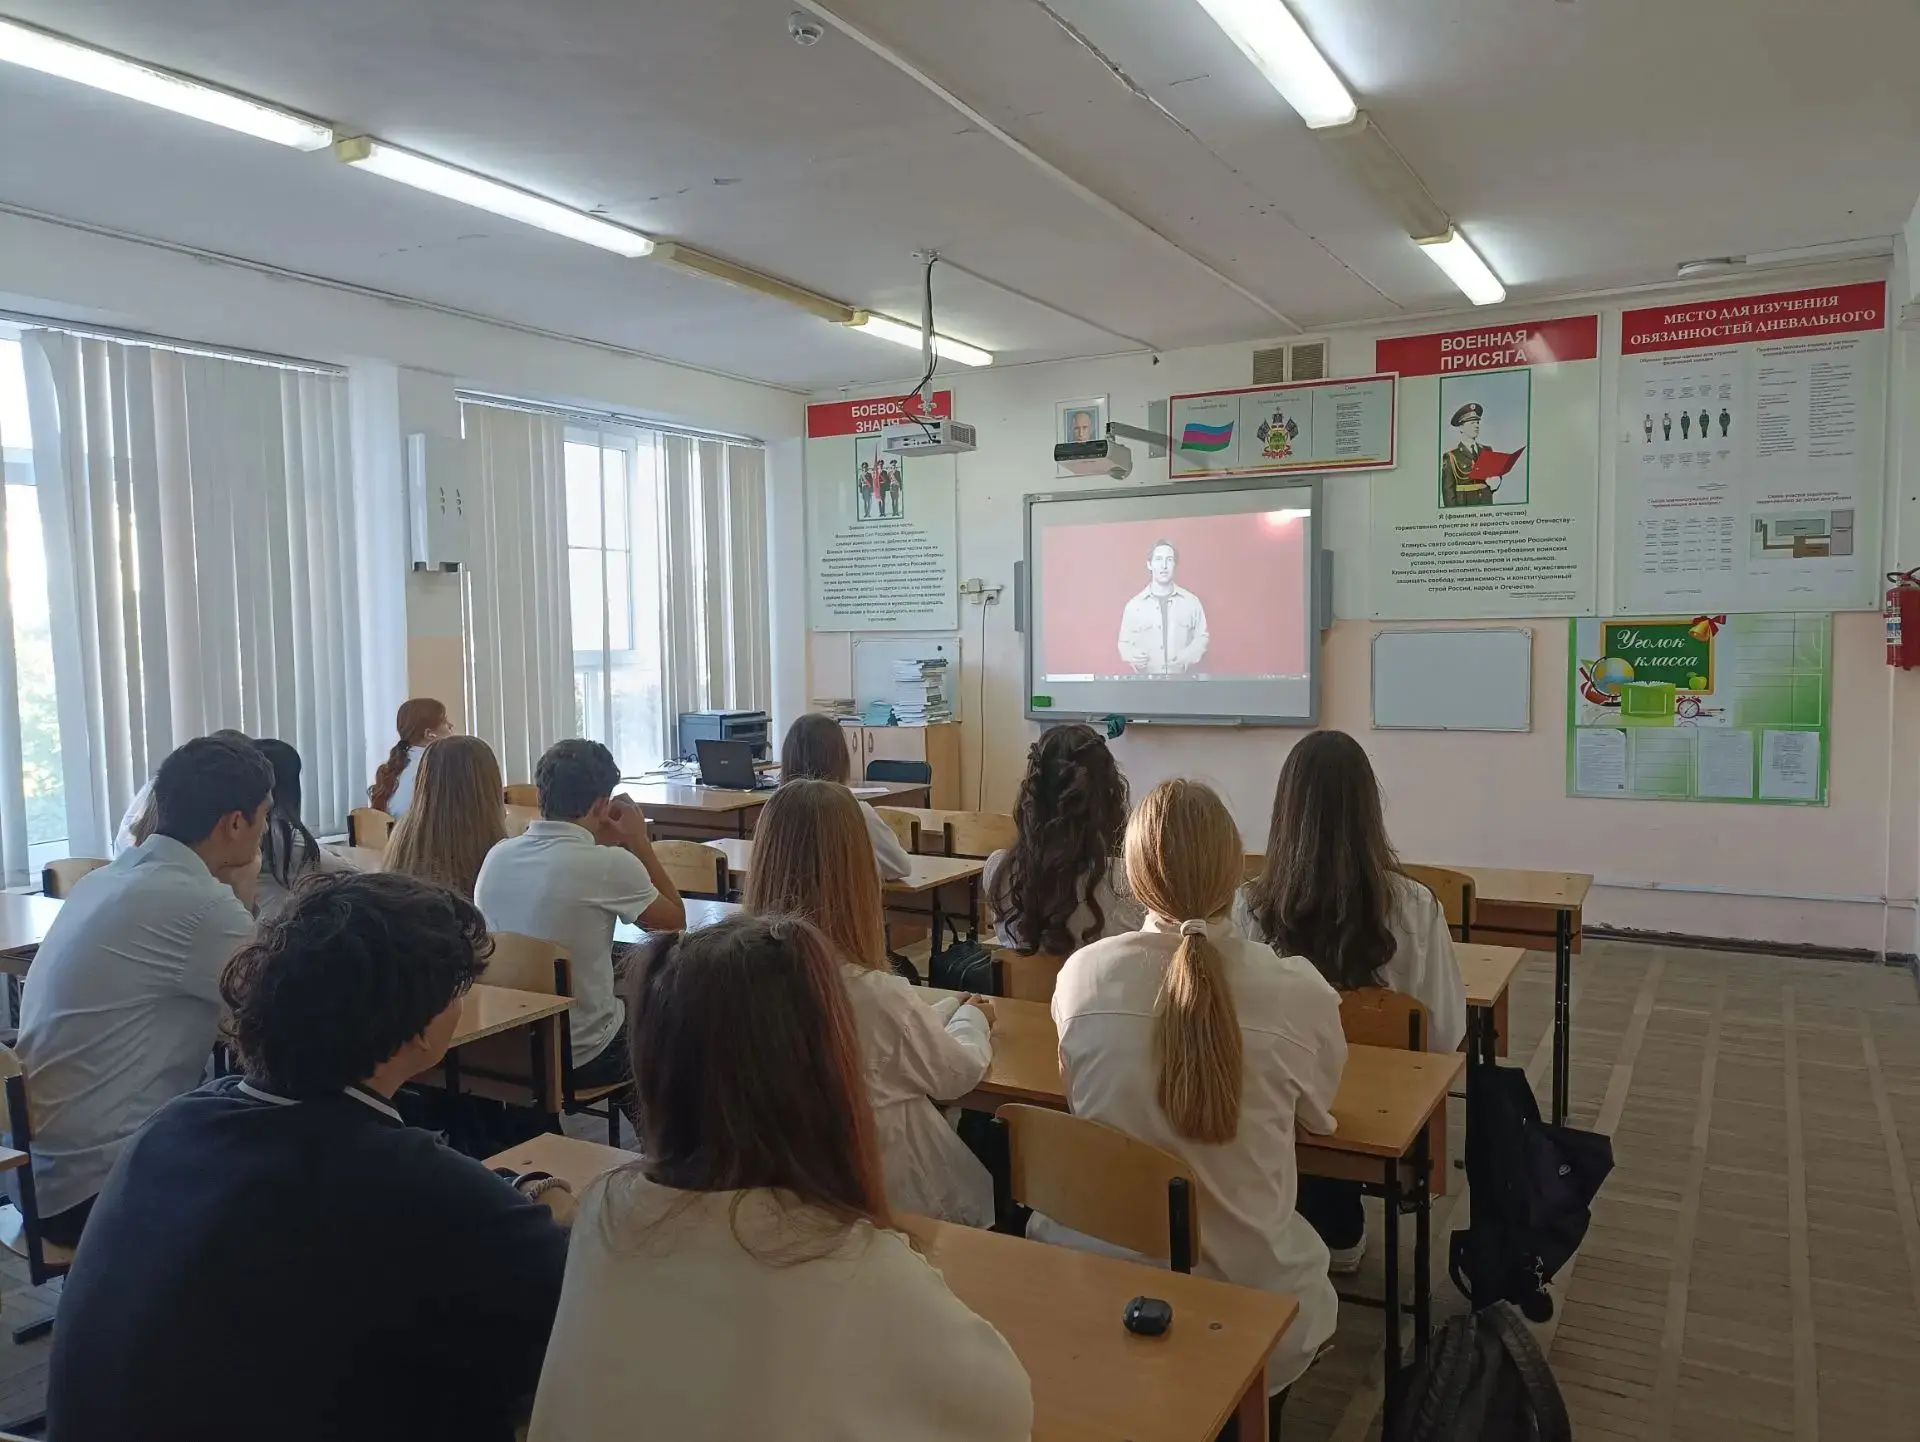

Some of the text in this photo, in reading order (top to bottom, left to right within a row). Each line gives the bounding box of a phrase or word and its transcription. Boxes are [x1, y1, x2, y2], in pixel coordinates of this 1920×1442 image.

[1664, 295, 1839, 326] МЕСТО ДЛЯ ИЗУЧЕНИЯ
[1630, 309, 1877, 346] ОБЯЗАННОСТЕЙ ДНЕВАЛЬНОГО
[1441, 330, 1527, 352] ВОЕННАЯ
[1440, 349, 1527, 370] ПРИСЯГА
[851, 401, 904, 418] БОЕВОЕ
[1617, 629, 1686, 650] Уголок
[1634, 656, 1699, 667] класса
